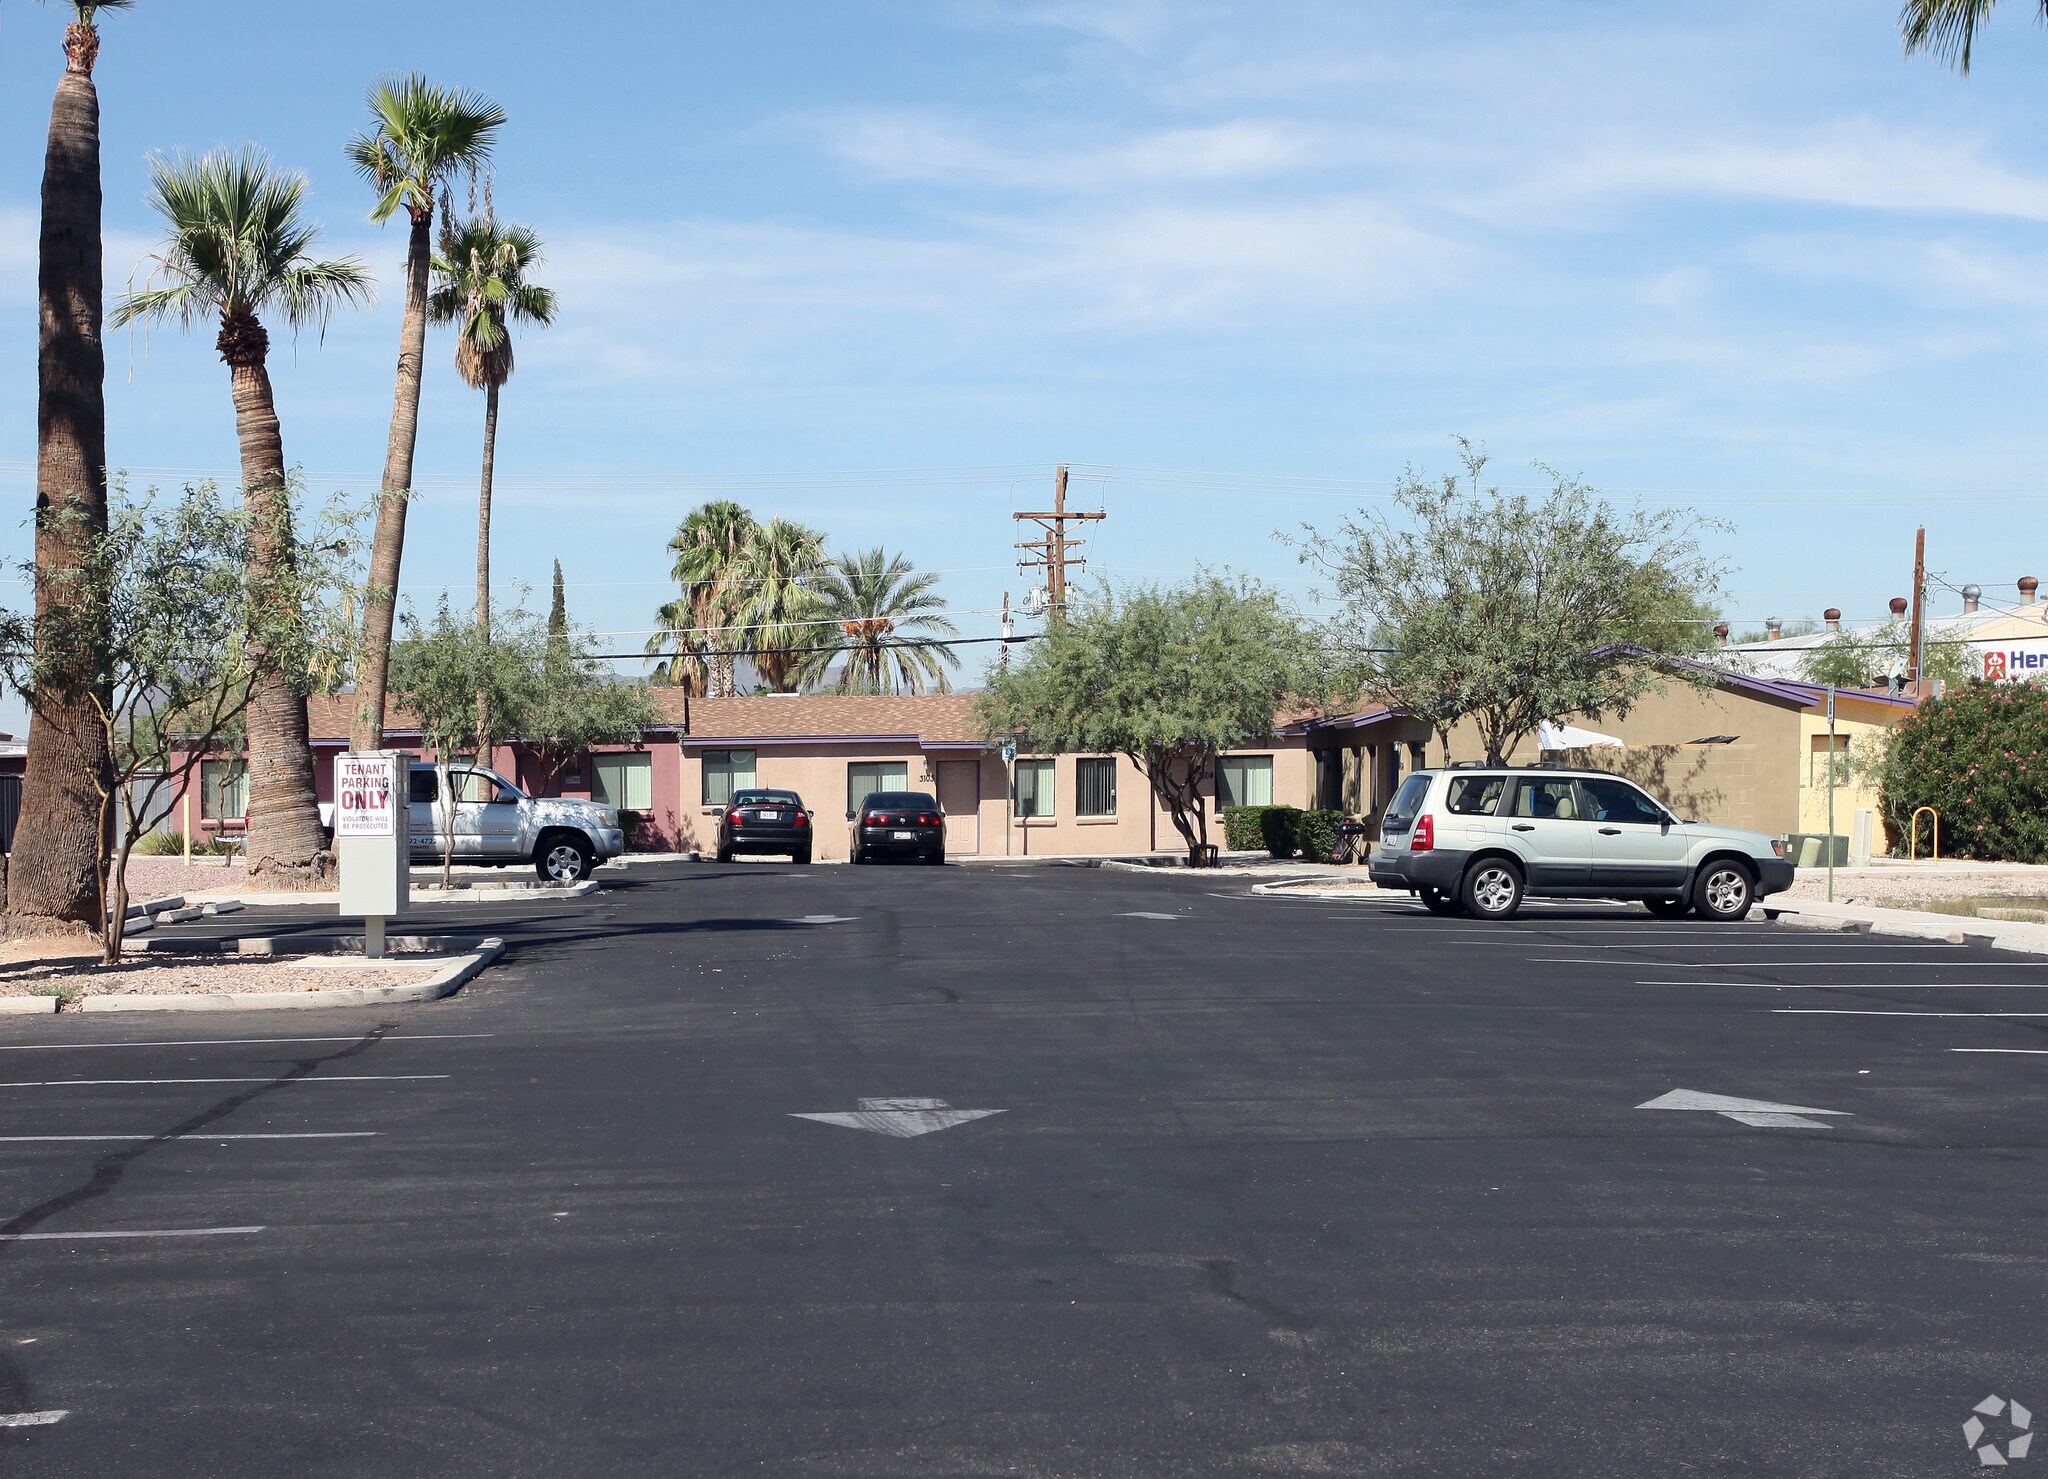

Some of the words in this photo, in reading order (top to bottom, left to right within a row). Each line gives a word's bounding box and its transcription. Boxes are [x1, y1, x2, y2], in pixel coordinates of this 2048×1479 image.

[2010, 651, 2048, 669] Her
[345, 764, 386, 775] TENANT
[342, 777, 388, 788] PARKING
[919, 774, 934, 782] 3103
[342, 791, 388, 809] ONLY
